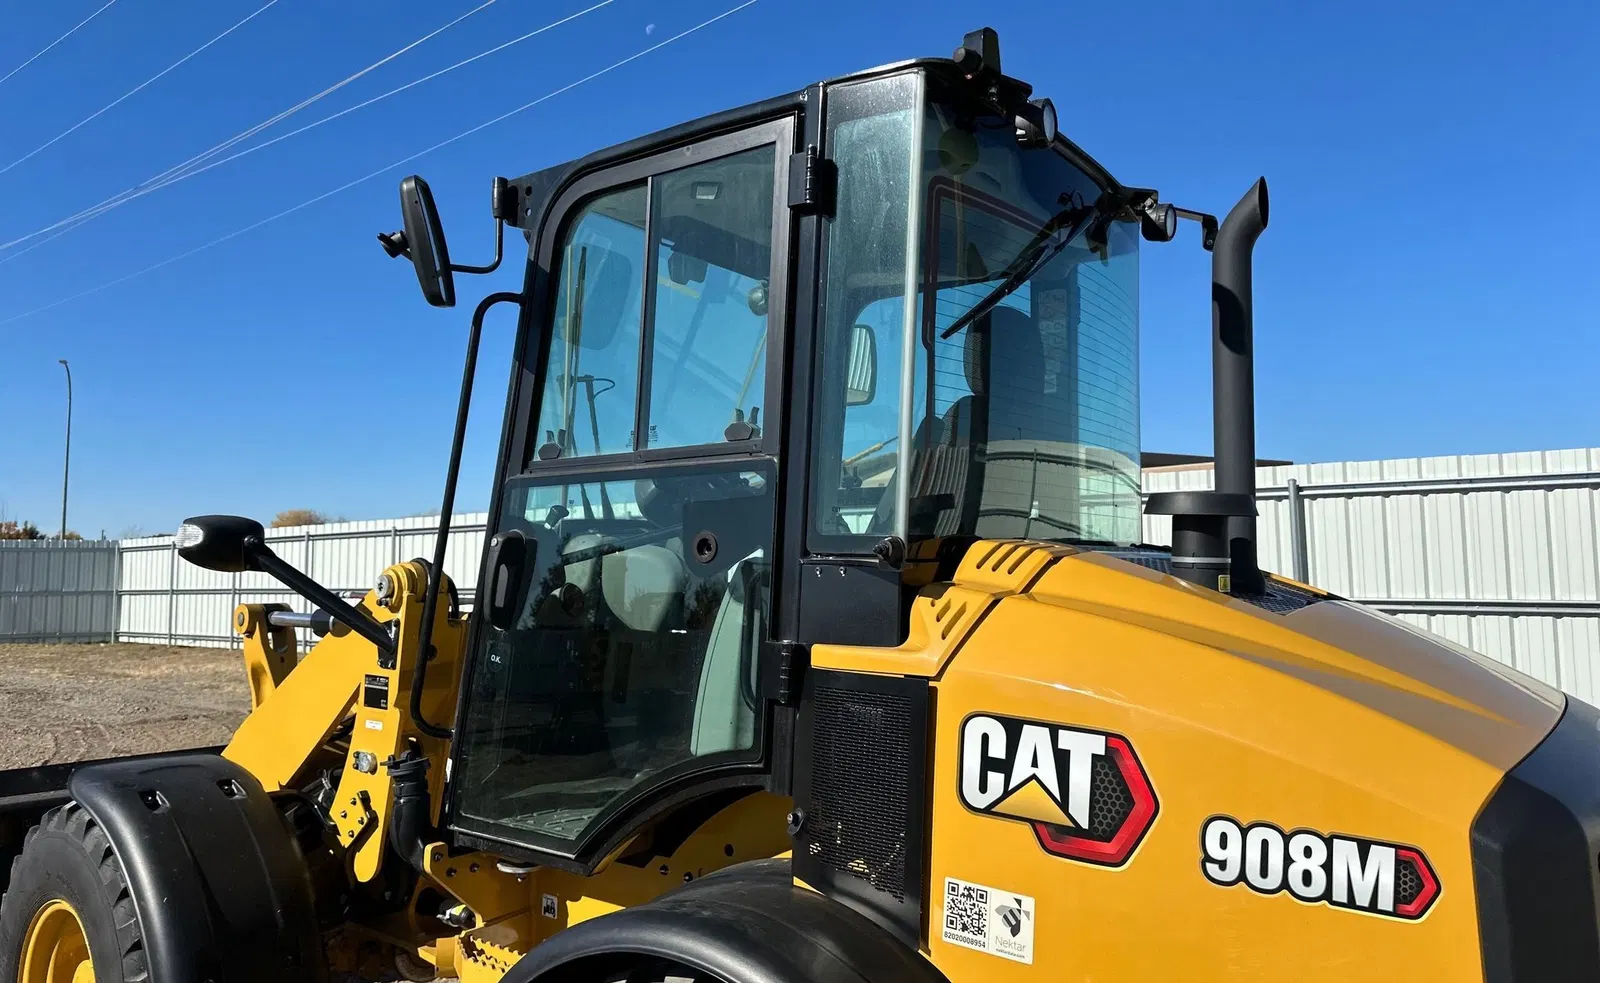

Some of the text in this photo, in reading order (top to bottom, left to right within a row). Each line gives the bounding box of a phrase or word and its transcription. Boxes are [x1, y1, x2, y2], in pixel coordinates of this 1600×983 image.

[962, 716, 1106, 830] CAT
[1205, 819, 1396, 913] 908M
[944, 931, 986, 948] 82020008954
[995, 936, 1026, 952] Nektar
